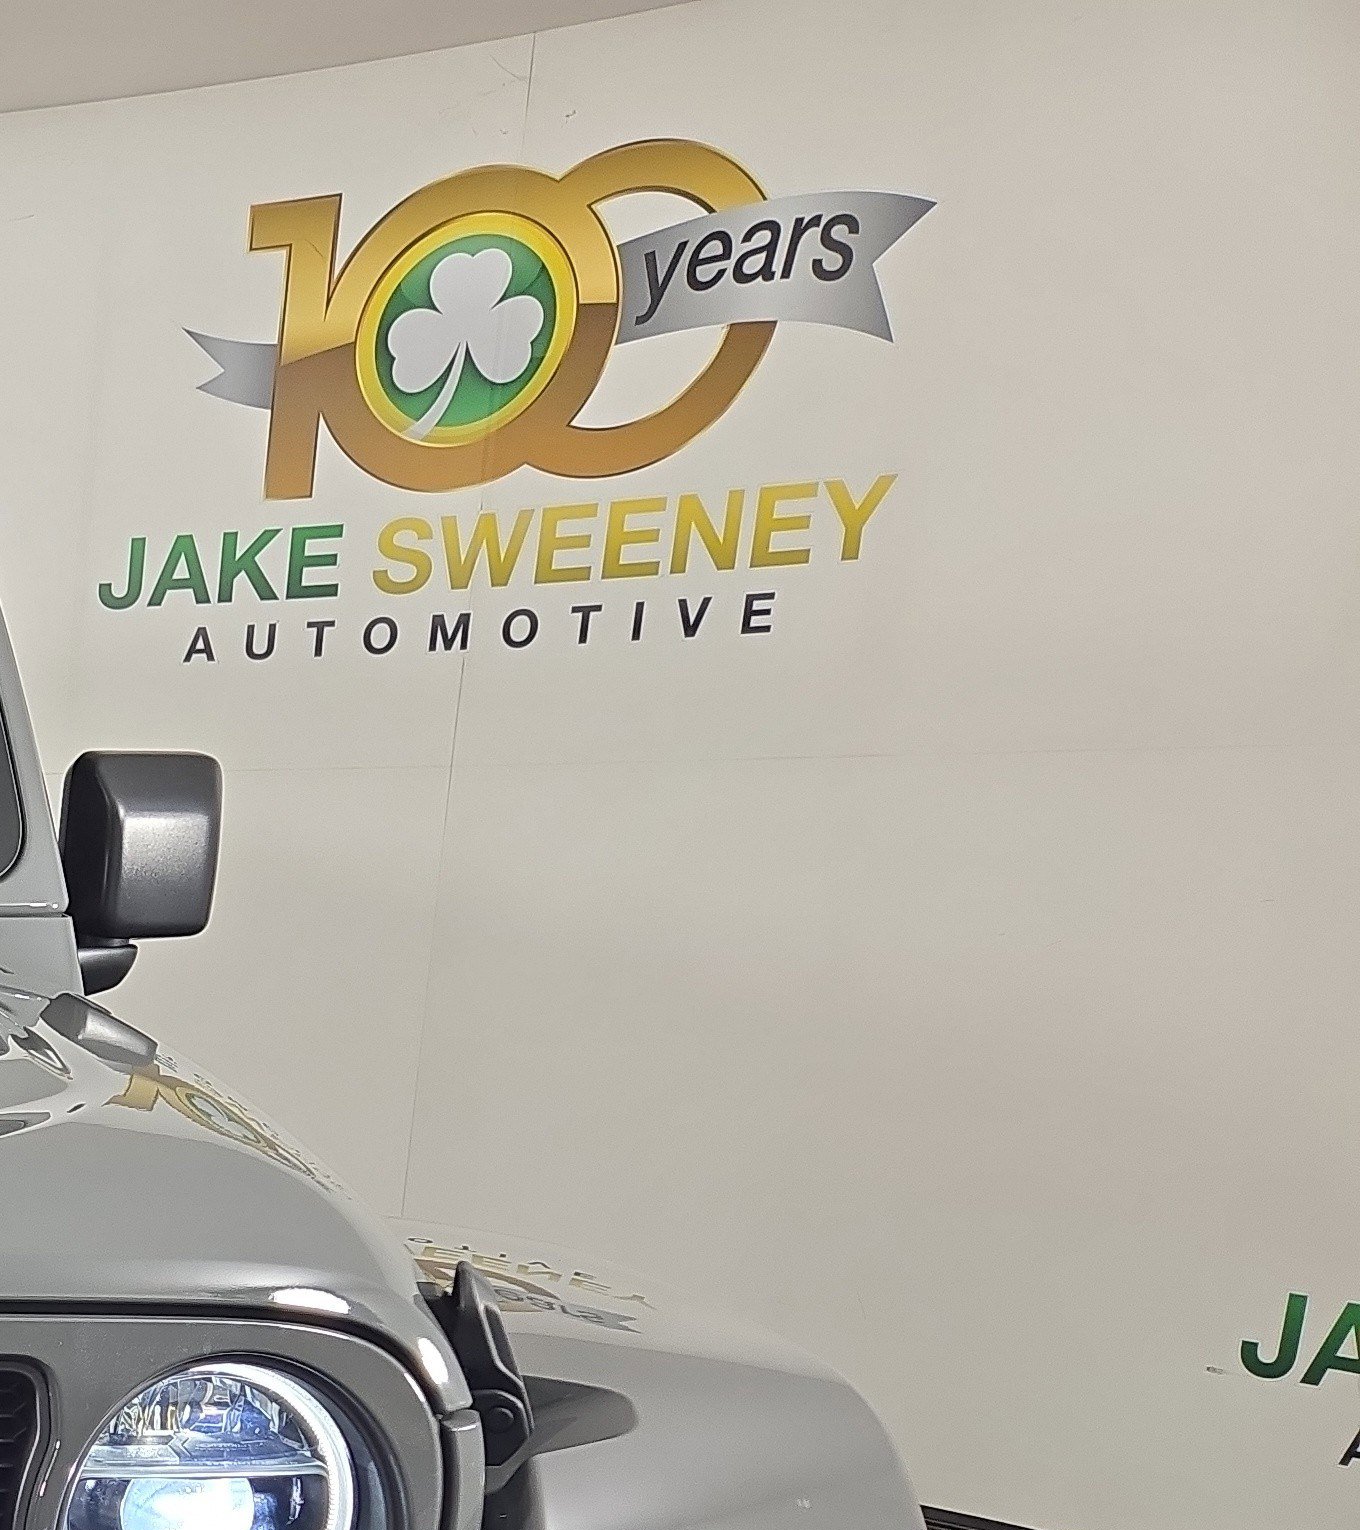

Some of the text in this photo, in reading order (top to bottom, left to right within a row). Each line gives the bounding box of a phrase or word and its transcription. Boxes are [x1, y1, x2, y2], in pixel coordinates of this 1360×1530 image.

[248, 138, 778, 498] 100
[635, 213, 860, 328] years
[97, 475, 898, 610] JAKE SWEENEY
[183, 591, 776, 663] AUTOMOTIVE
[1240, 1293, 1360, 1386] JA
